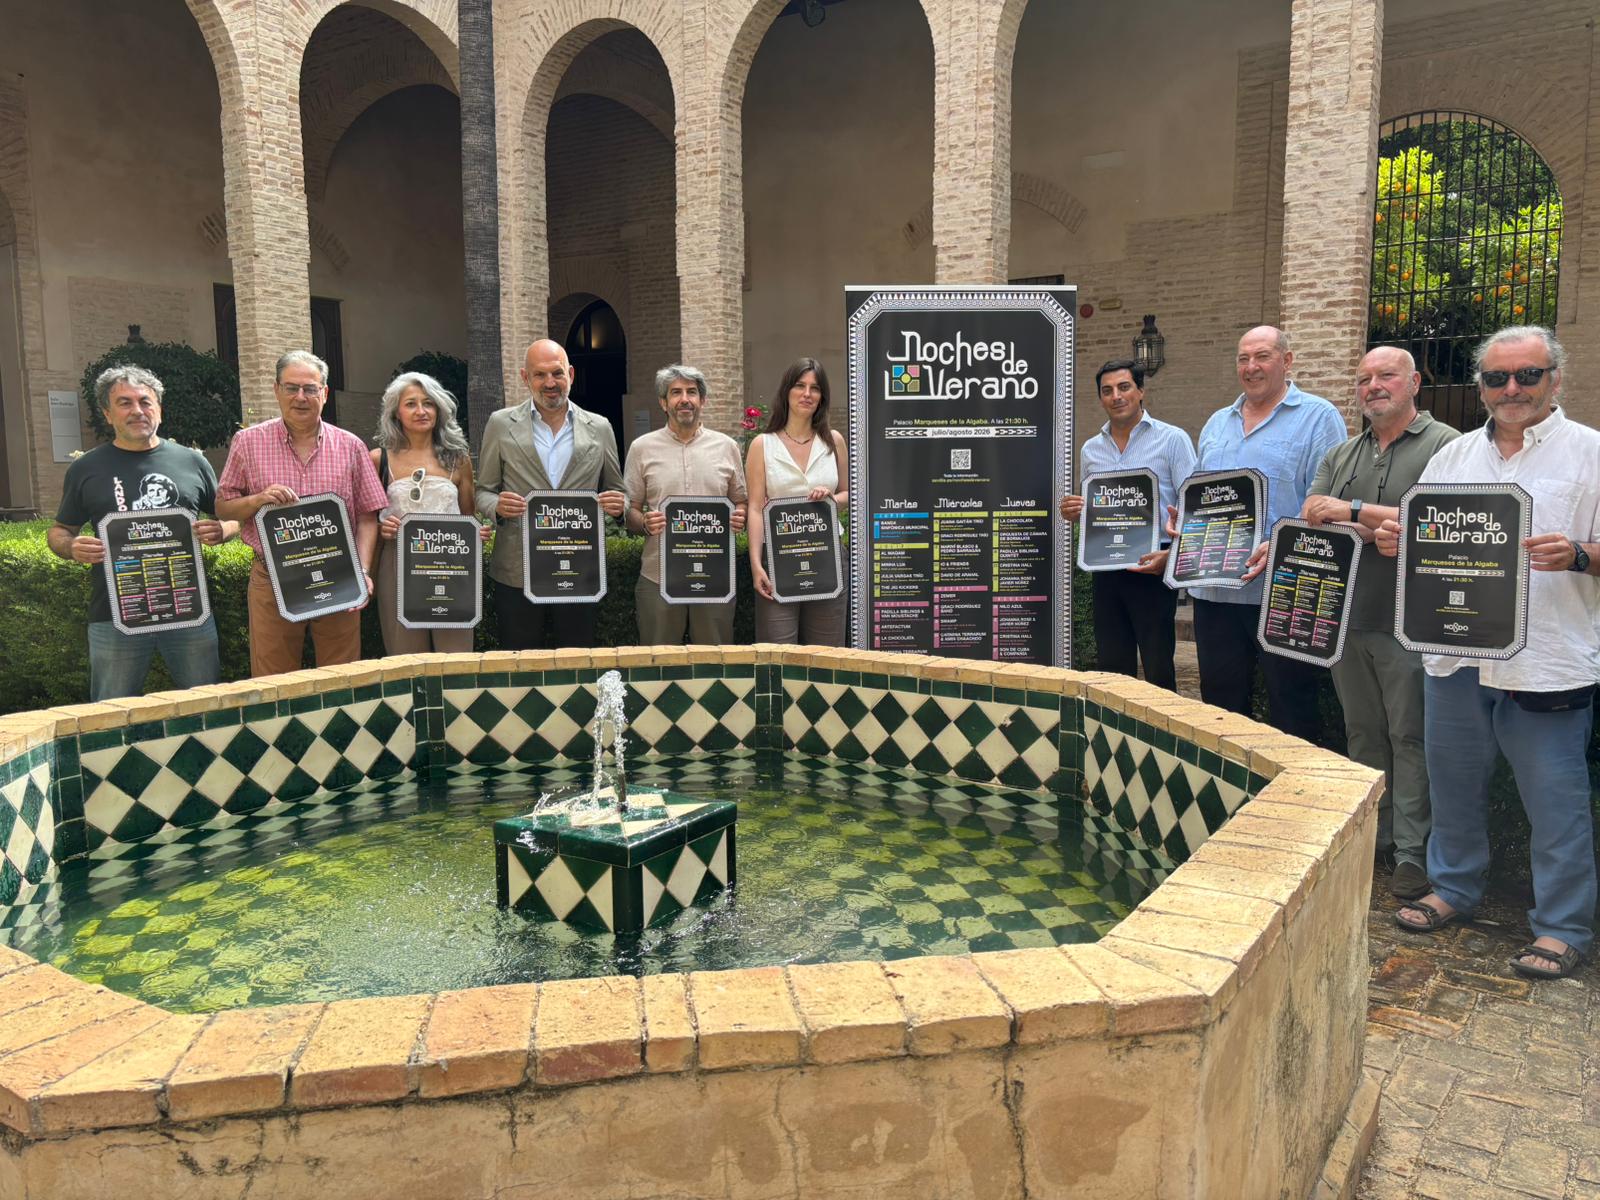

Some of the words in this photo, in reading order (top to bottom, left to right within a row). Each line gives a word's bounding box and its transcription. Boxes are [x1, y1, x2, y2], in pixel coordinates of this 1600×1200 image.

[887, 330, 1006, 372] Noches
[1001, 341, 1028, 375] de
[884, 364, 1039, 400] Verano
[931, 428, 973, 436] julio/agosto
[1094, 484, 1135, 498] Noches
[1134, 486, 1144, 499] de
[880, 498, 918, 509] Martes
[1000, 496, 1035, 508] Jueves
[1093, 495, 1147, 508] Verano
[536, 504, 579, 519] Noches
[578, 508, 588, 521] de
[672, 509, 713, 524] Noches
[711, 514, 720, 526] de
[776, 510, 815, 525] Noches
[814, 512, 823, 523] de
[1418, 506, 1487, 529] Noches
[1484, 513, 1501, 531] de
[128, 521, 162, 531] Noches
[274, 513, 321, 530] Noches
[321, 514, 332, 527] de
[535, 517, 592, 529] Verano
[672, 521, 724, 534] Verano
[128, 529, 172, 540] Verano
[274, 524, 338, 545] Verano
[776, 523, 827, 535] Verano
[1416, 523, 1507, 544] Verano
[411, 528, 457, 544] Noches
[455, 533, 466, 546] de
[1296, 532, 1327, 546] Noches
[411, 541, 470, 554] Verano
[1294, 542, 1334, 557] Verano
[1421, 558, 1455, 566] Marqueses
